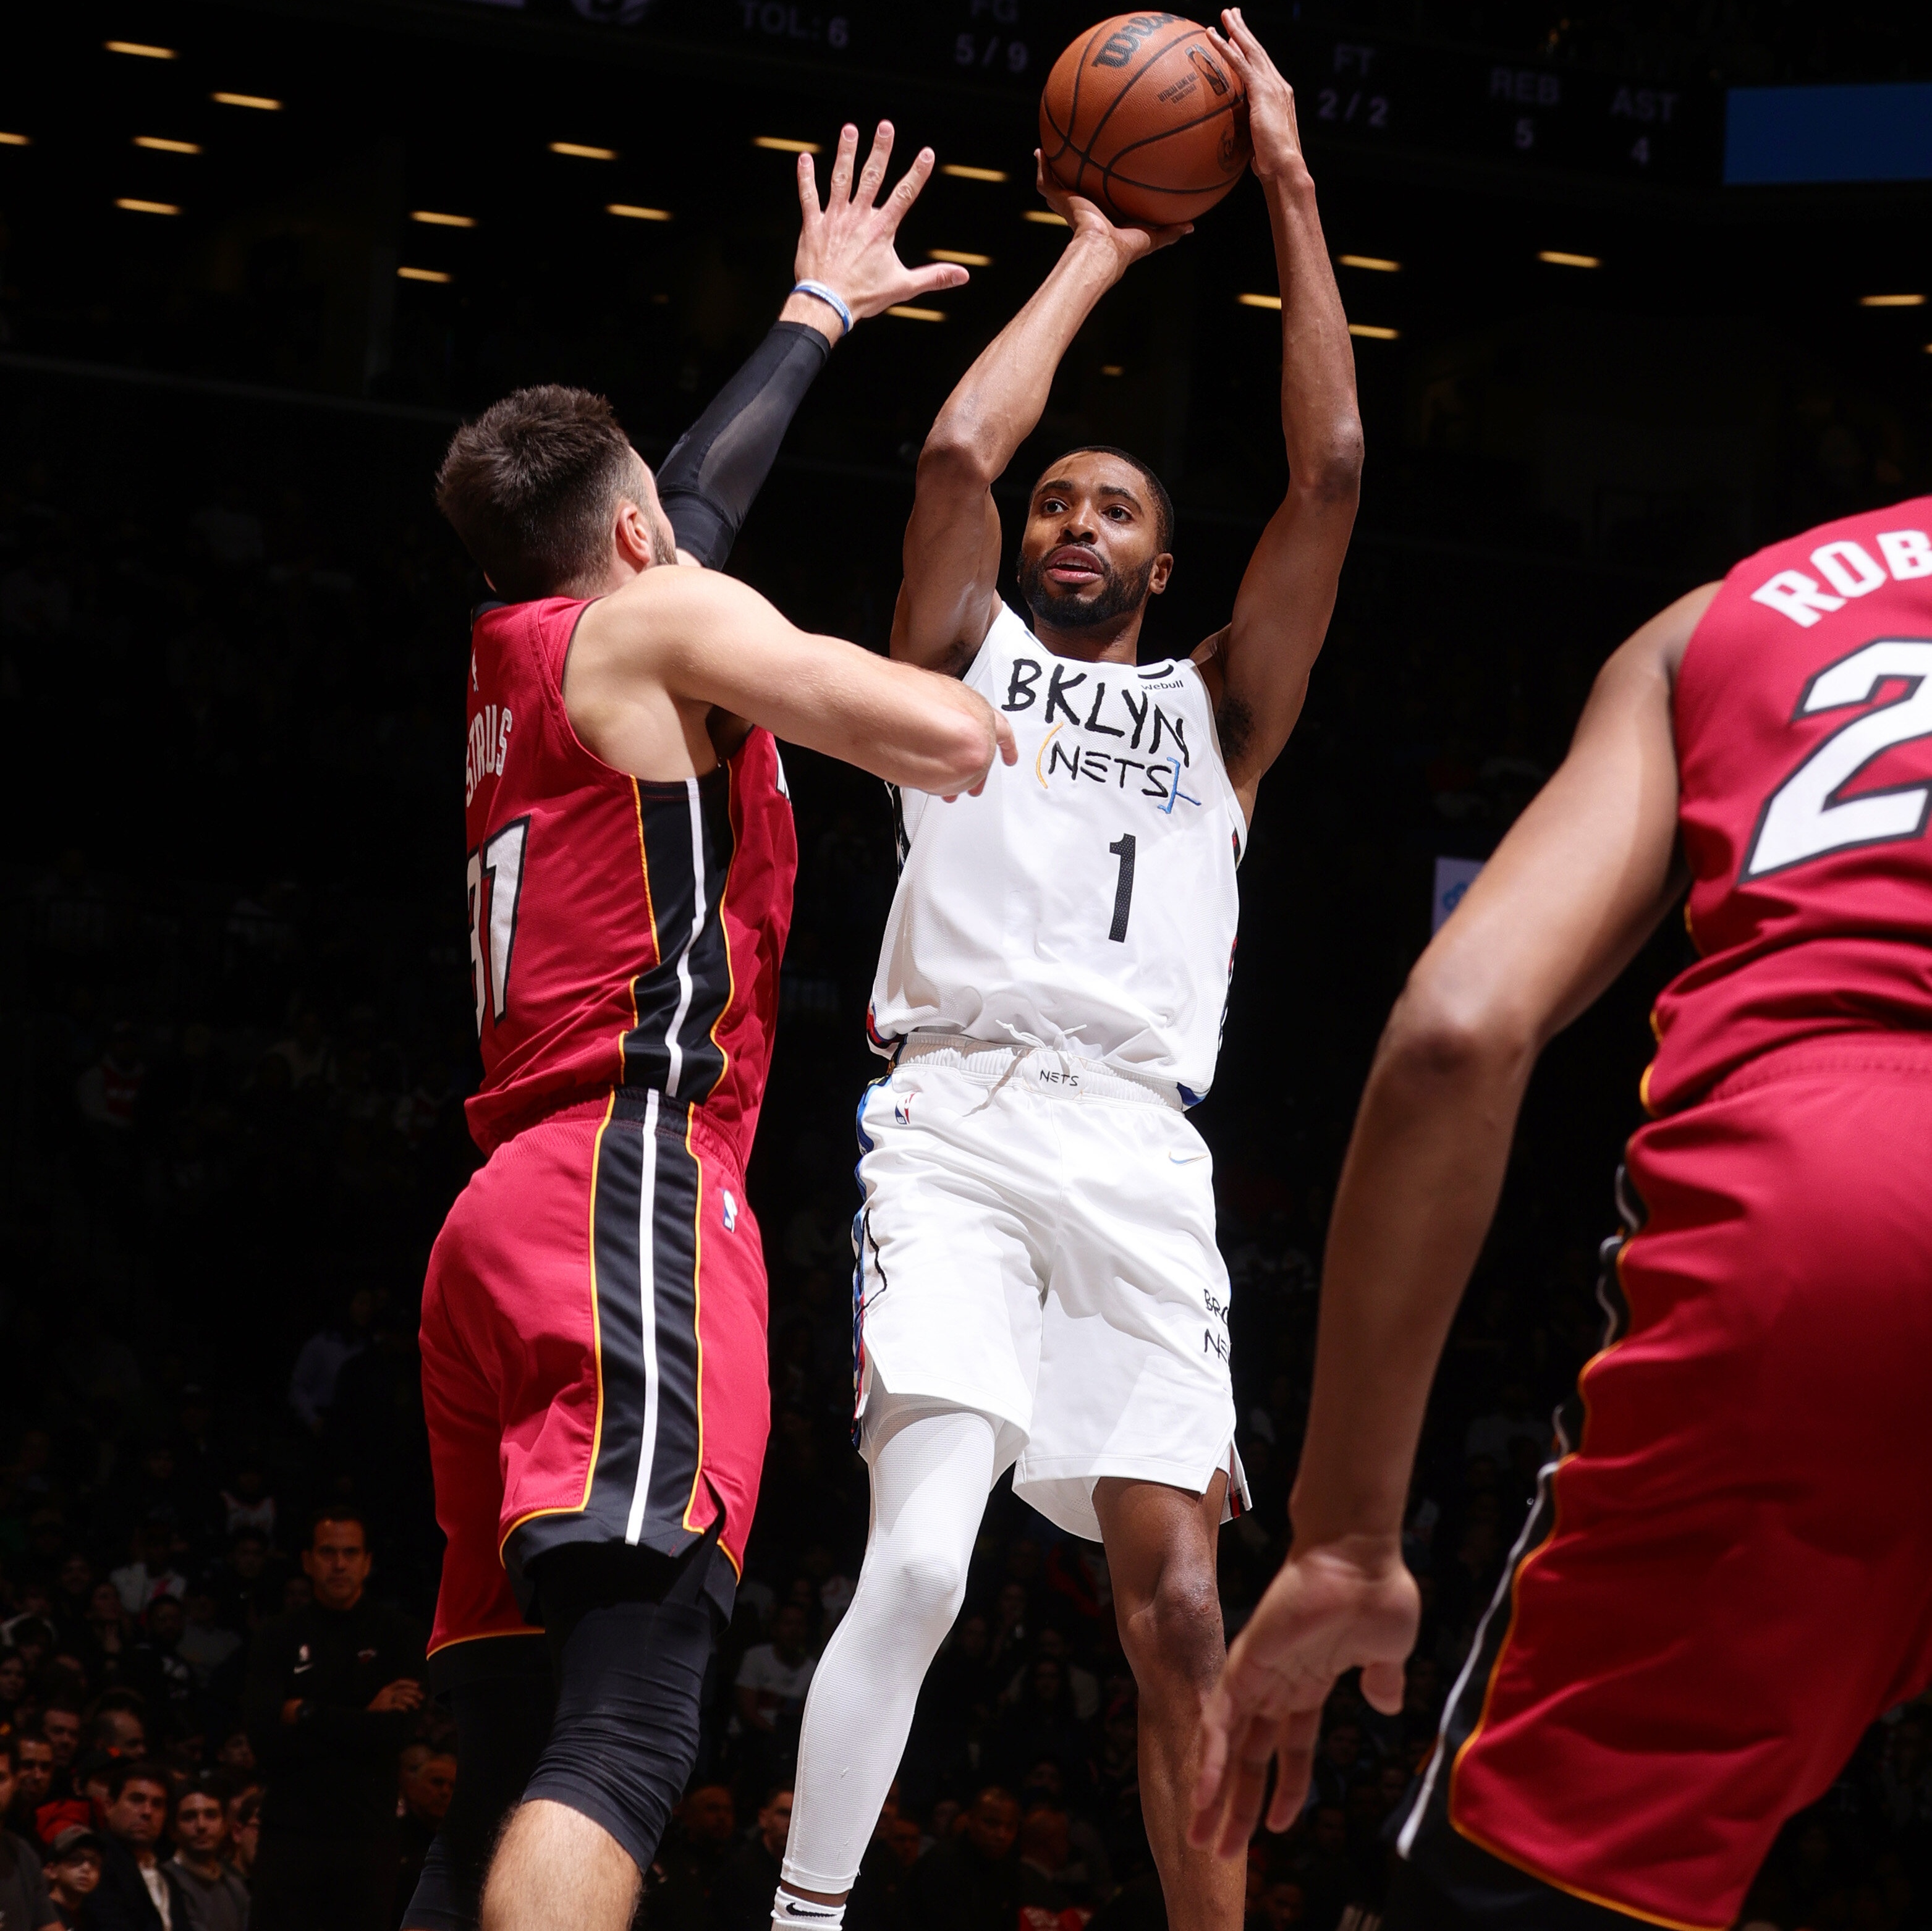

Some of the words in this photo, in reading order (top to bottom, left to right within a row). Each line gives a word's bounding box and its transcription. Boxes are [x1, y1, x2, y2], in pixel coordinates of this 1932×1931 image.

[827, 15, 850, 49] 6
[1332, 41, 1377, 78] FT
[1489, 65, 1562, 107] REB
[1610, 84, 1682, 124] AST
[1514, 118, 1535, 151] 5
[1629, 135, 1652, 168] 4
[1750, 530, 1932, 628] ROB
[1142, 680, 1184, 690] webull
[1001, 658, 1190, 767] BKLYN
[1736, 636, 1932, 886] 2
[1108, 833, 1136, 943] 1
[1040, 1069, 1079, 1086] NETS
